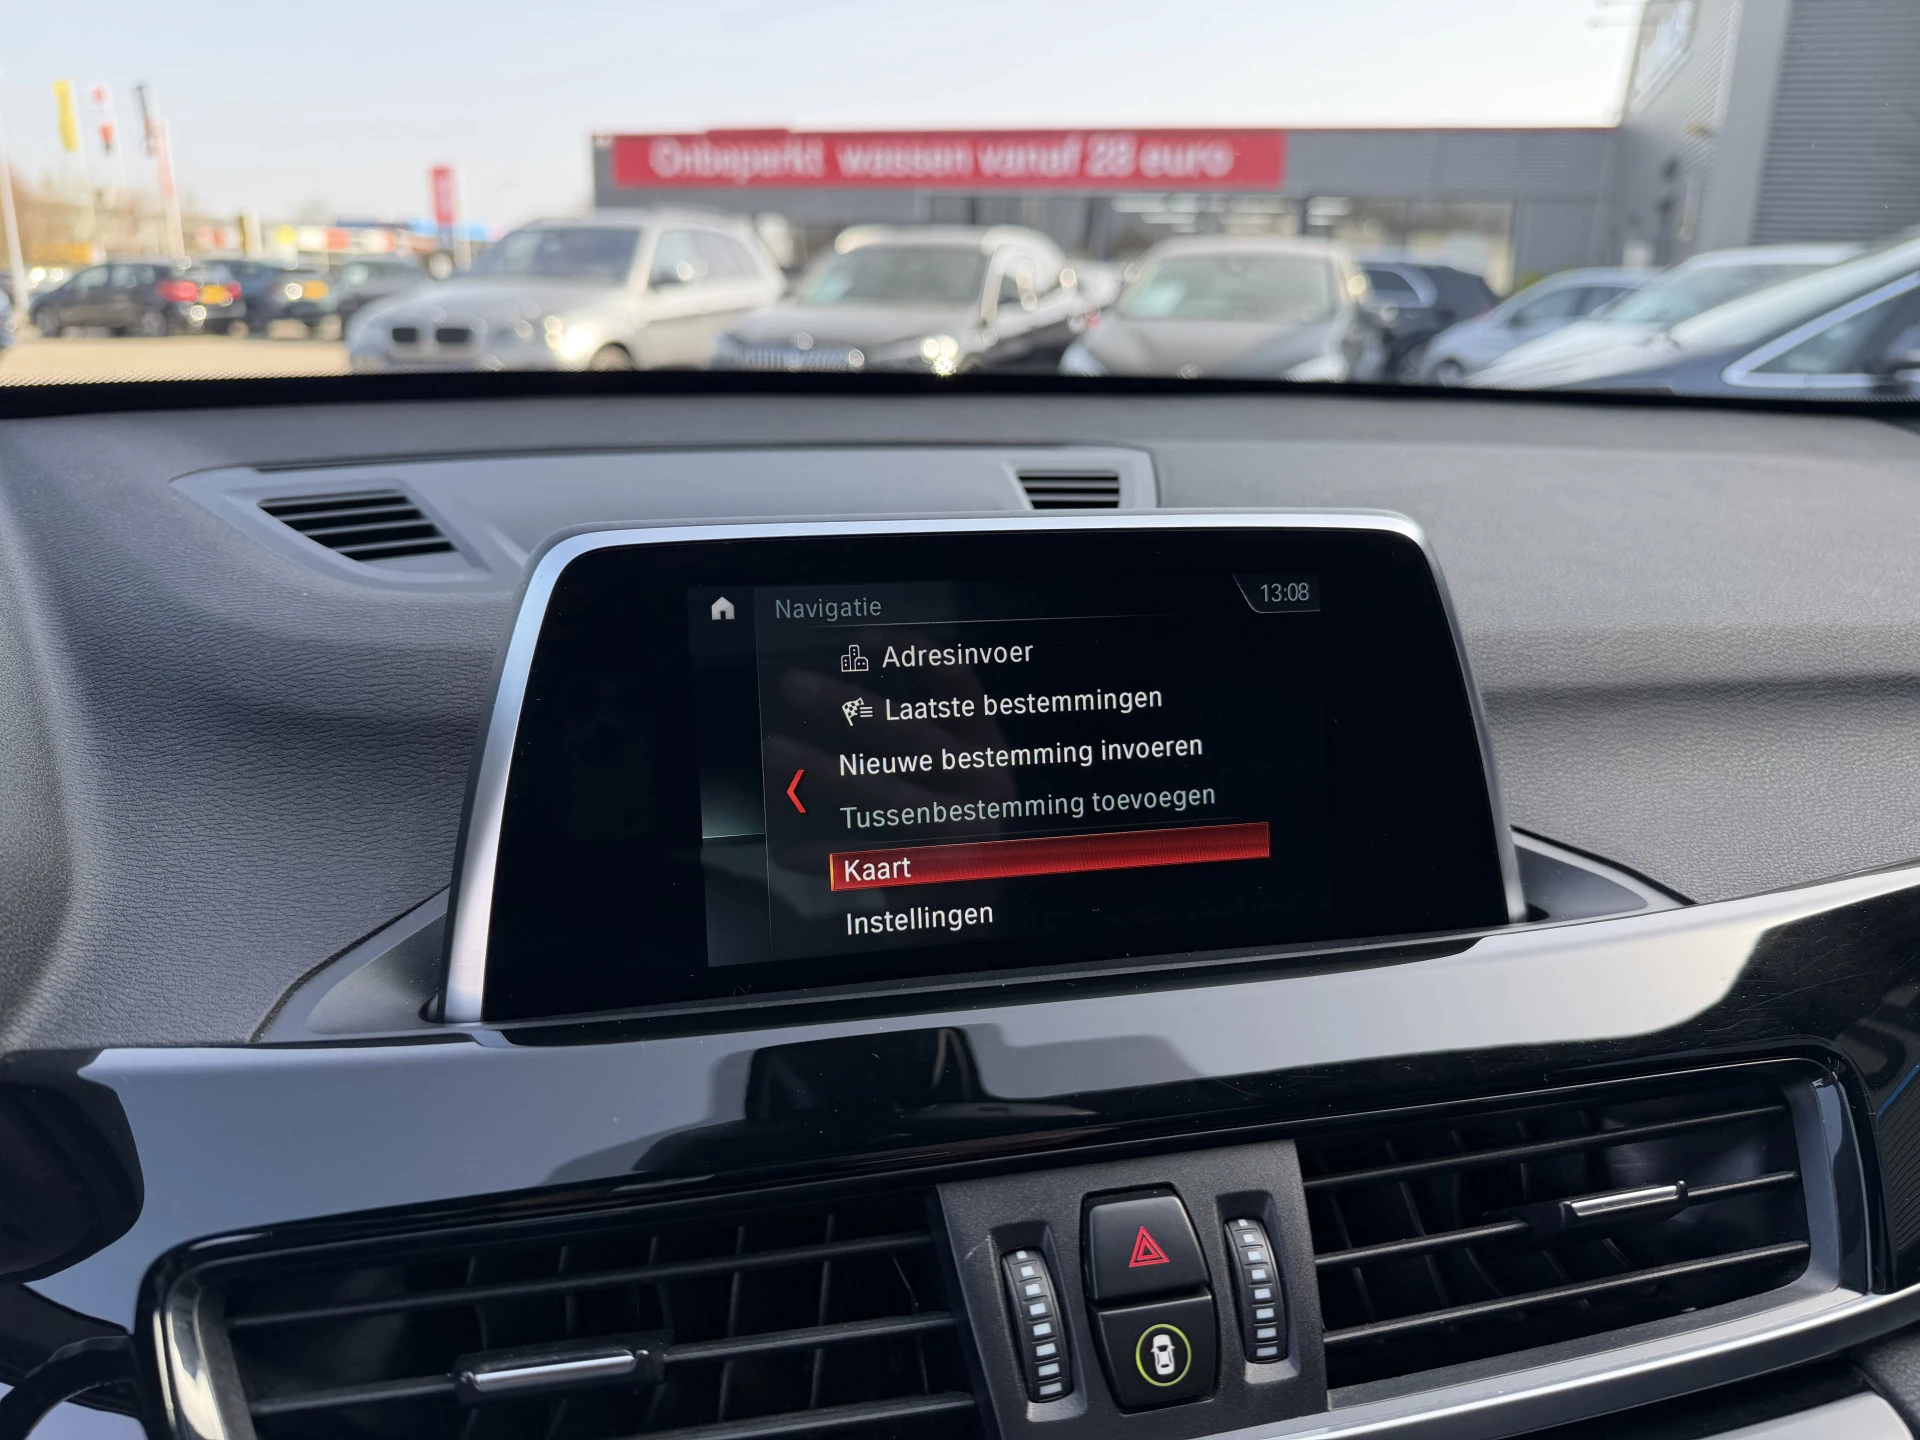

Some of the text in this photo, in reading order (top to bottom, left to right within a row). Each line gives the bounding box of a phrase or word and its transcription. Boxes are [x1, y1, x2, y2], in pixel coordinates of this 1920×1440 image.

[1139, 141, 1235, 178] euro
[1260, 582, 1310, 603] 13:08
[775, 597, 882, 622] Navigatie
[882, 643, 1034, 669] Adresinvoer
[885, 688, 1162, 721] Laatste bestemmingen
[839, 738, 1203, 776] Nieuwe bestemming invoeren
[840, 788, 1215, 829] Tussenbestemming toevoegen
[844, 857, 912, 882] Kaart
[846, 905, 994, 936] Instellingen
